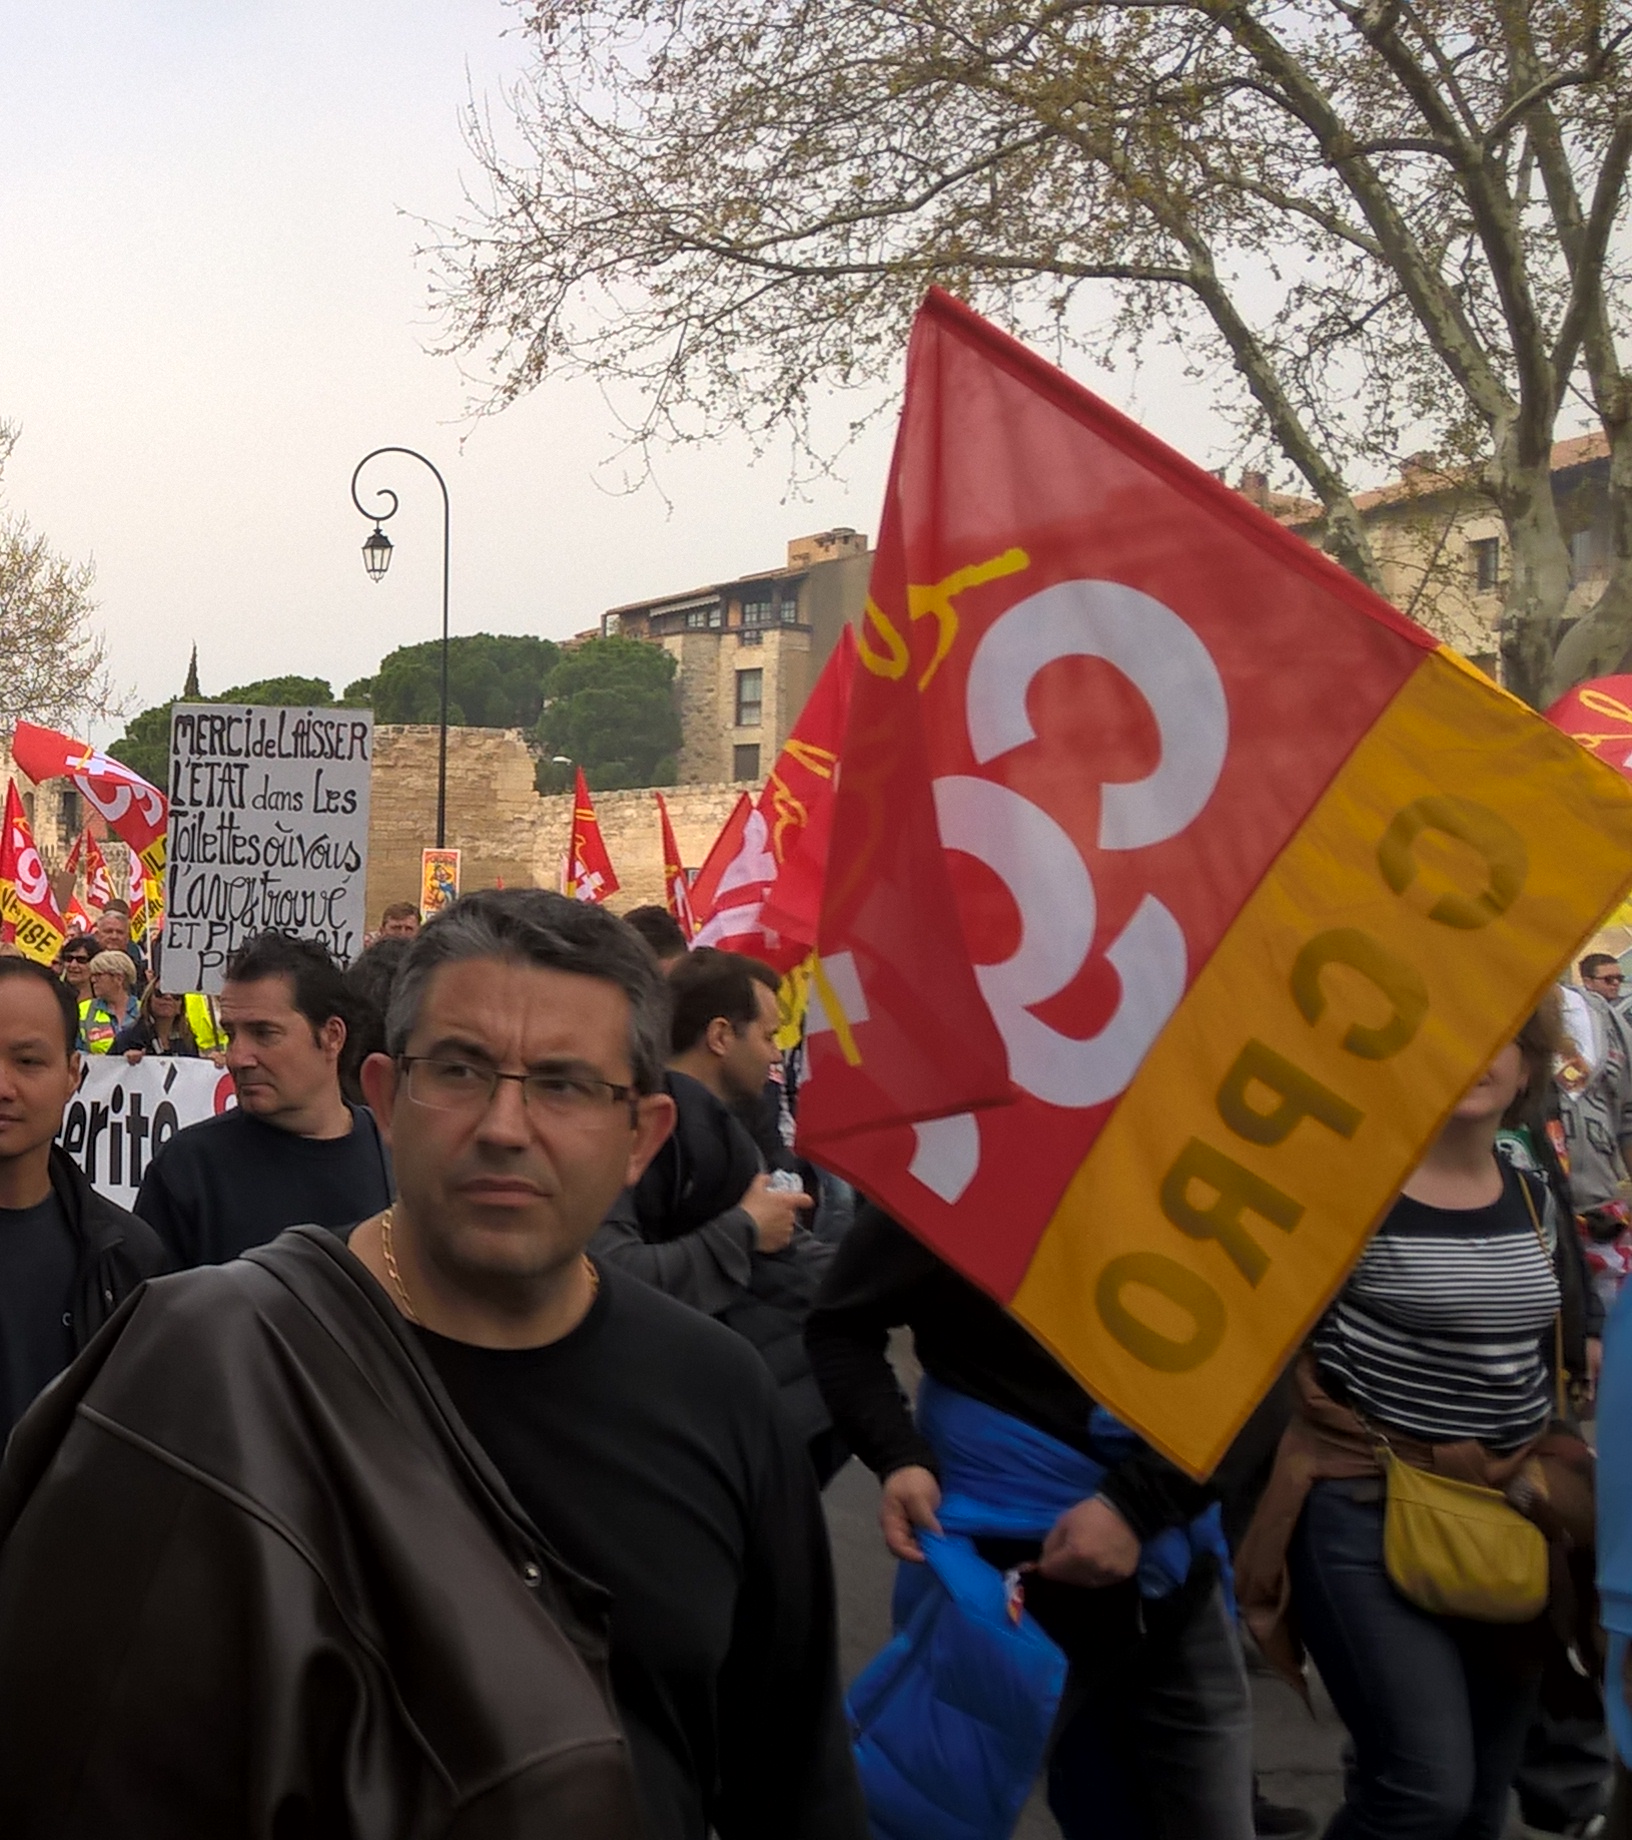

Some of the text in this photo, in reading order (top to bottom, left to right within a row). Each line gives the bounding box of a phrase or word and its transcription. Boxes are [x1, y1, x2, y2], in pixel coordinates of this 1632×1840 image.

[252, 718, 276, 758] de
[252, 774, 304, 812] dans
[169, 810, 262, 866] Toilettes
[260, 870, 351, 930] trouvé
[168, 921, 201, 950] ET
